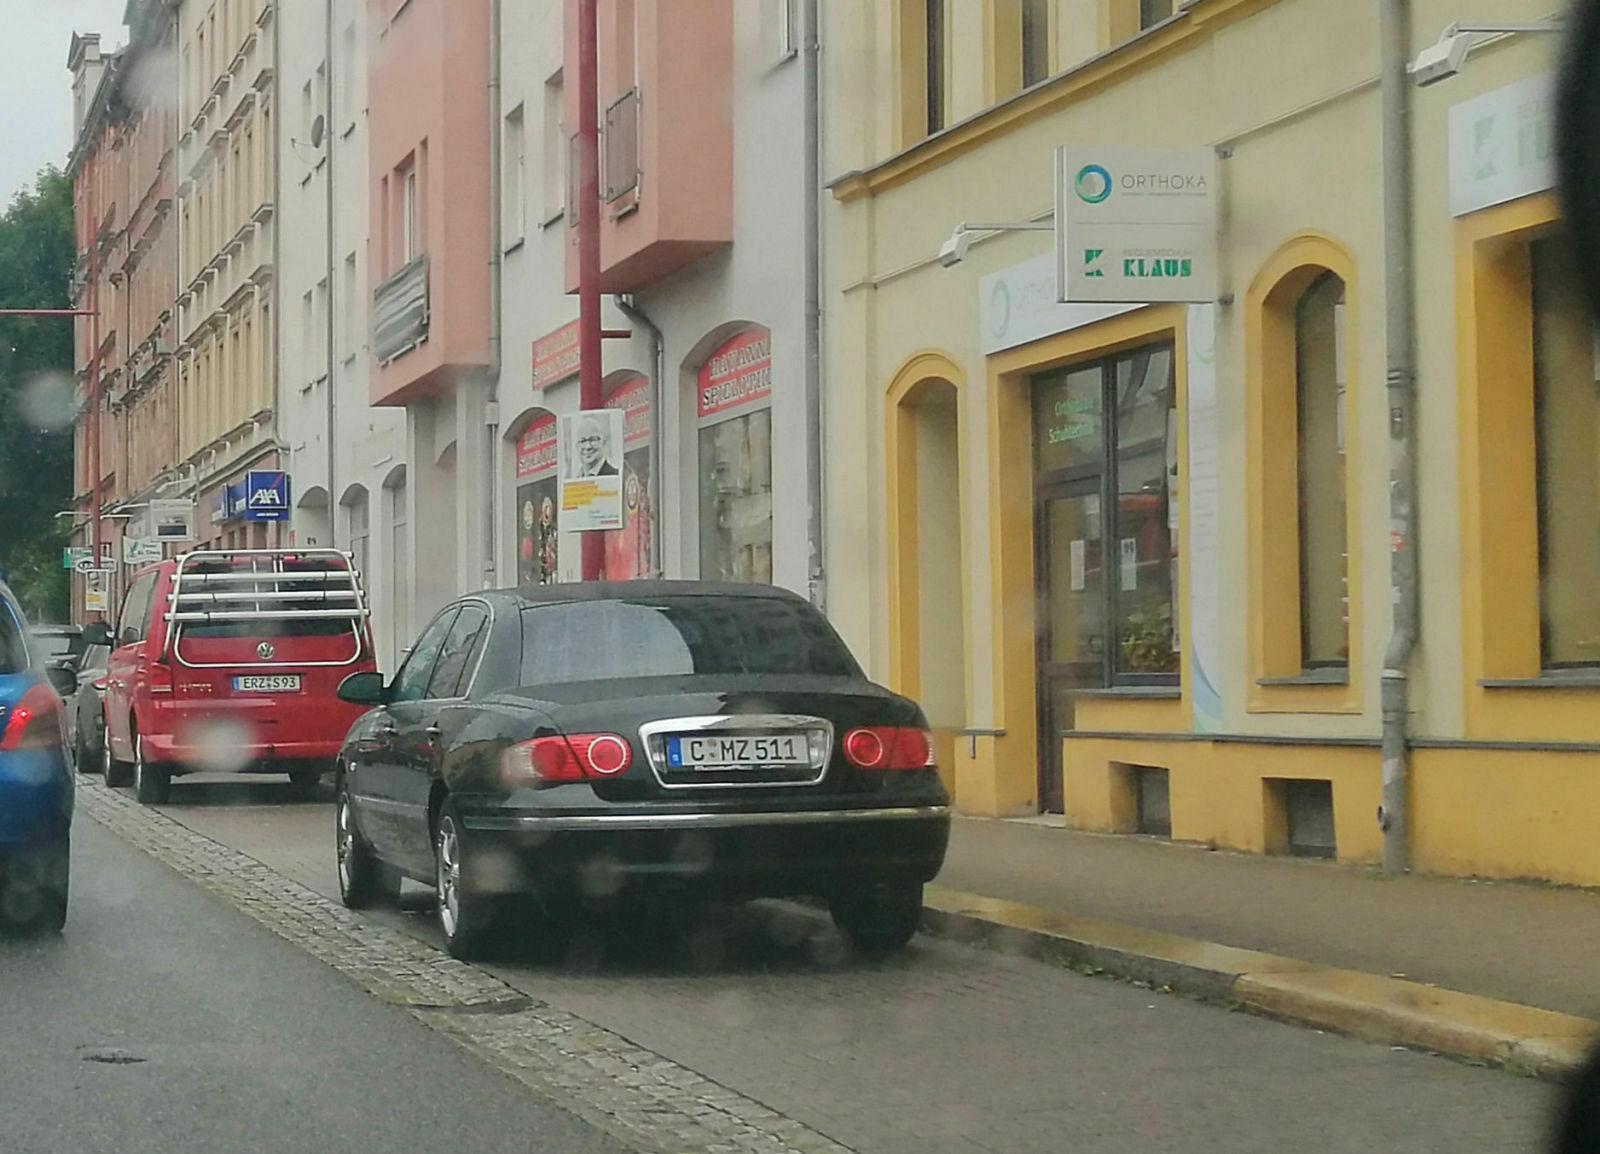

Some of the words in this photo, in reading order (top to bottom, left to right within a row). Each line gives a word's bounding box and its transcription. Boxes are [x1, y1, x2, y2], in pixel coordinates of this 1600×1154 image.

[1120, 174, 1207, 190] ORTHOKA
[1123, 258, 1192, 278] KLAUS
[248, 488, 281, 505] AXA
[243, 677, 265, 689] ERZ
[690, 740, 705, 761] C
